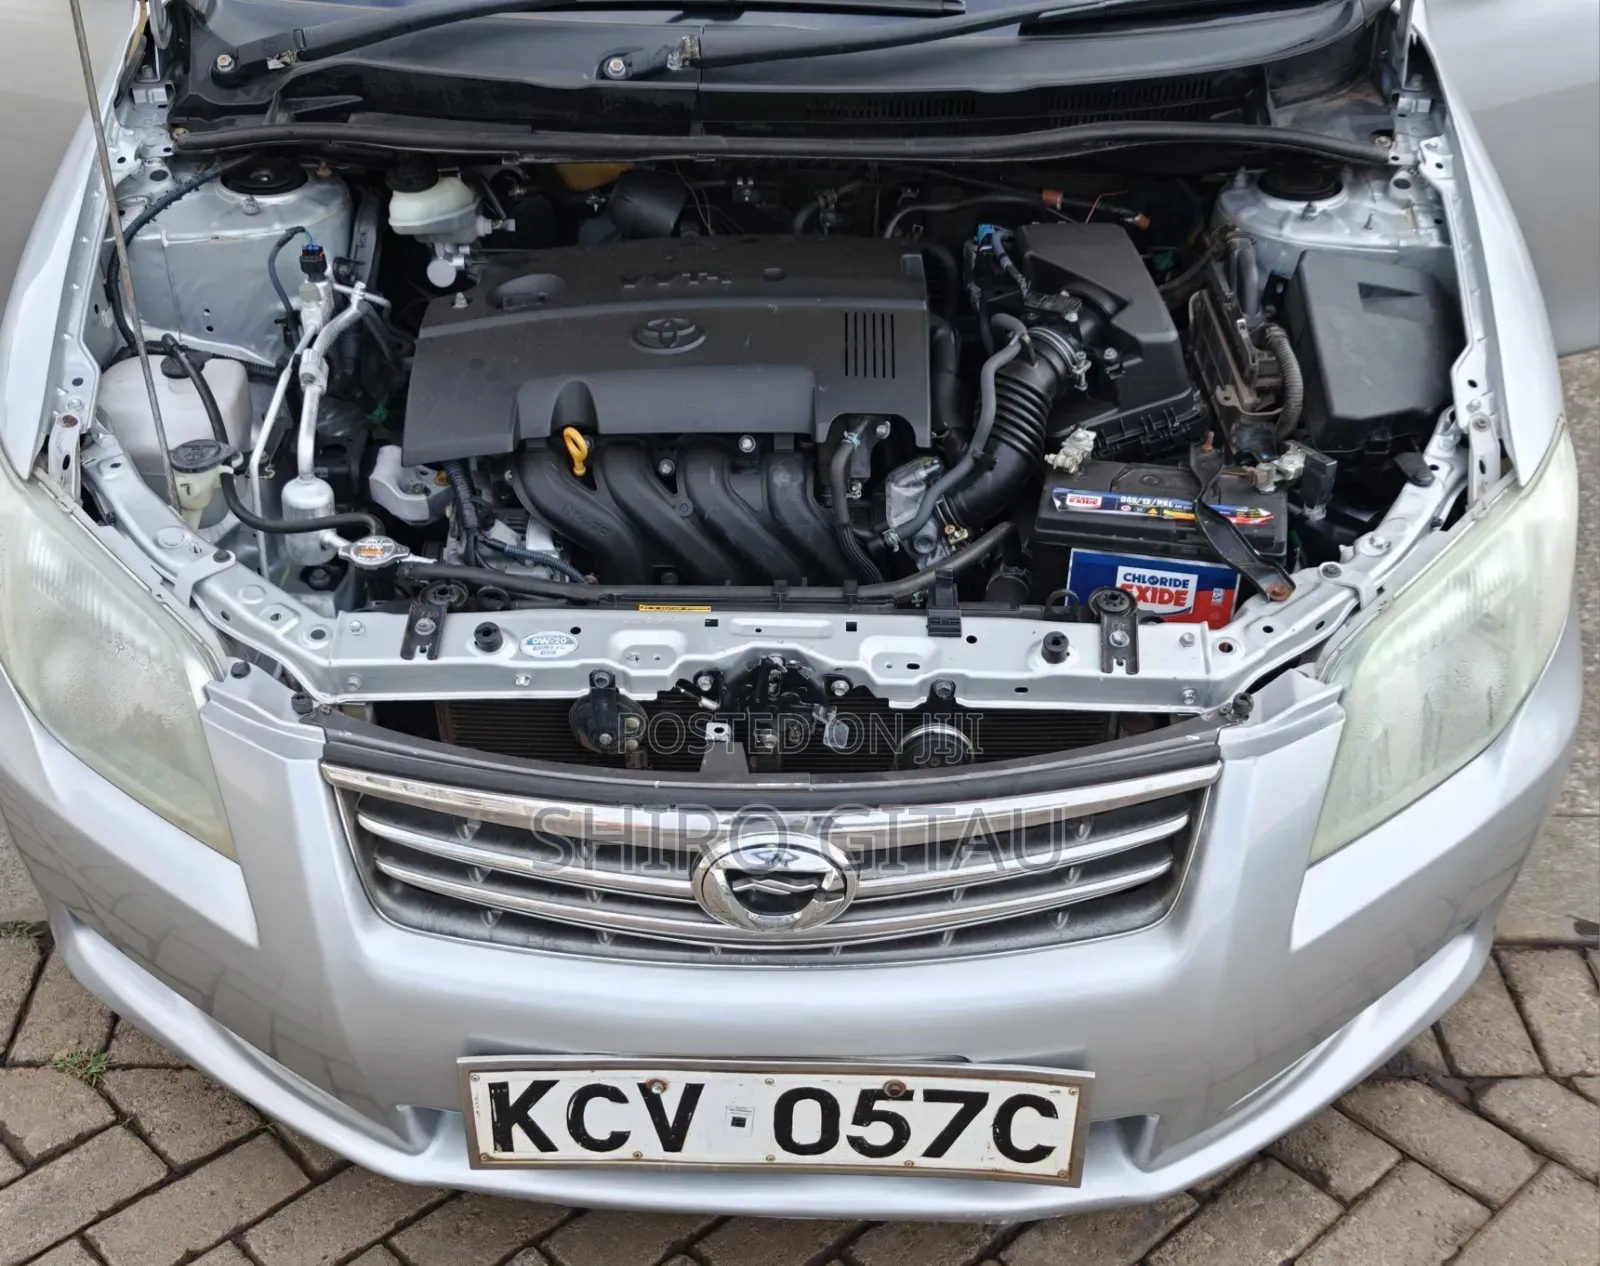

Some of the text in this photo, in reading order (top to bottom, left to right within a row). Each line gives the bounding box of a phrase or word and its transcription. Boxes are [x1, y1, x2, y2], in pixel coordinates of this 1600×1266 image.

[1123, 573, 1190, 588] CHLORIDE
[488, 1079, 1059, 1164] KCV 057C
